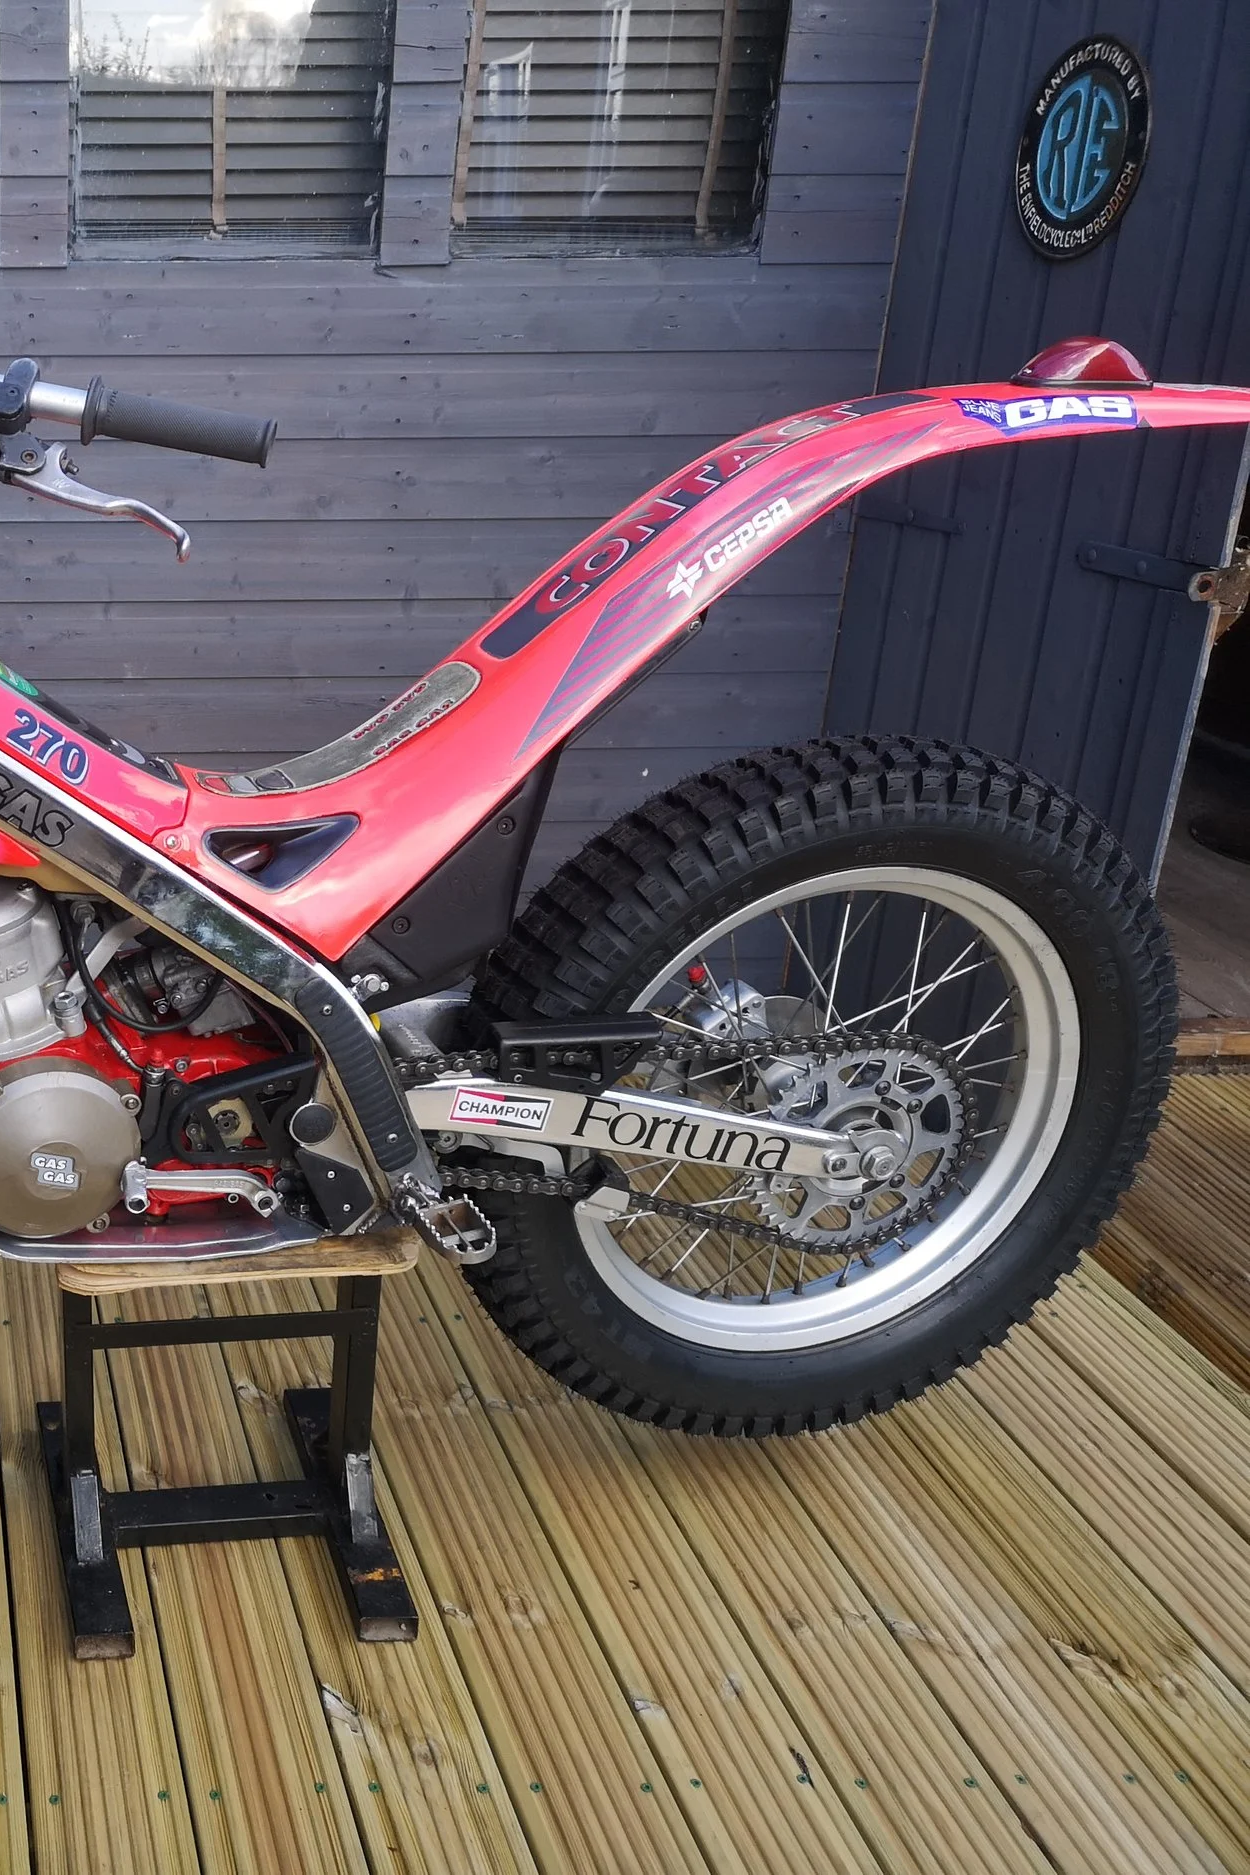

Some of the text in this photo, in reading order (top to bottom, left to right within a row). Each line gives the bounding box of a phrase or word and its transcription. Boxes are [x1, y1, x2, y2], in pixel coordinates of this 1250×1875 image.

[1036, 42, 1141, 115] MANUFACTURED BY
[1019, 163, 1031, 194] THE
[1093, 161, 1136, 234] REDDITCH
[1021, 192, 1048, 239] ENFIELD
[1043, 226, 1072, 248] CYCLE
[963, 404, 1002, 424] JEANS
[1005, 396, 1133, 427] GAS
[535, 404, 862, 614] CONTACT
[703, 496, 793, 573] CEPSA
[6, 708, 90, 785] 270
[458, 1100, 543, 1121] CHAMPION
[571, 1096, 791, 1172] Fortuna
[34, 1156, 67, 1170] GAS
[43, 1171, 75, 1184] GAS
